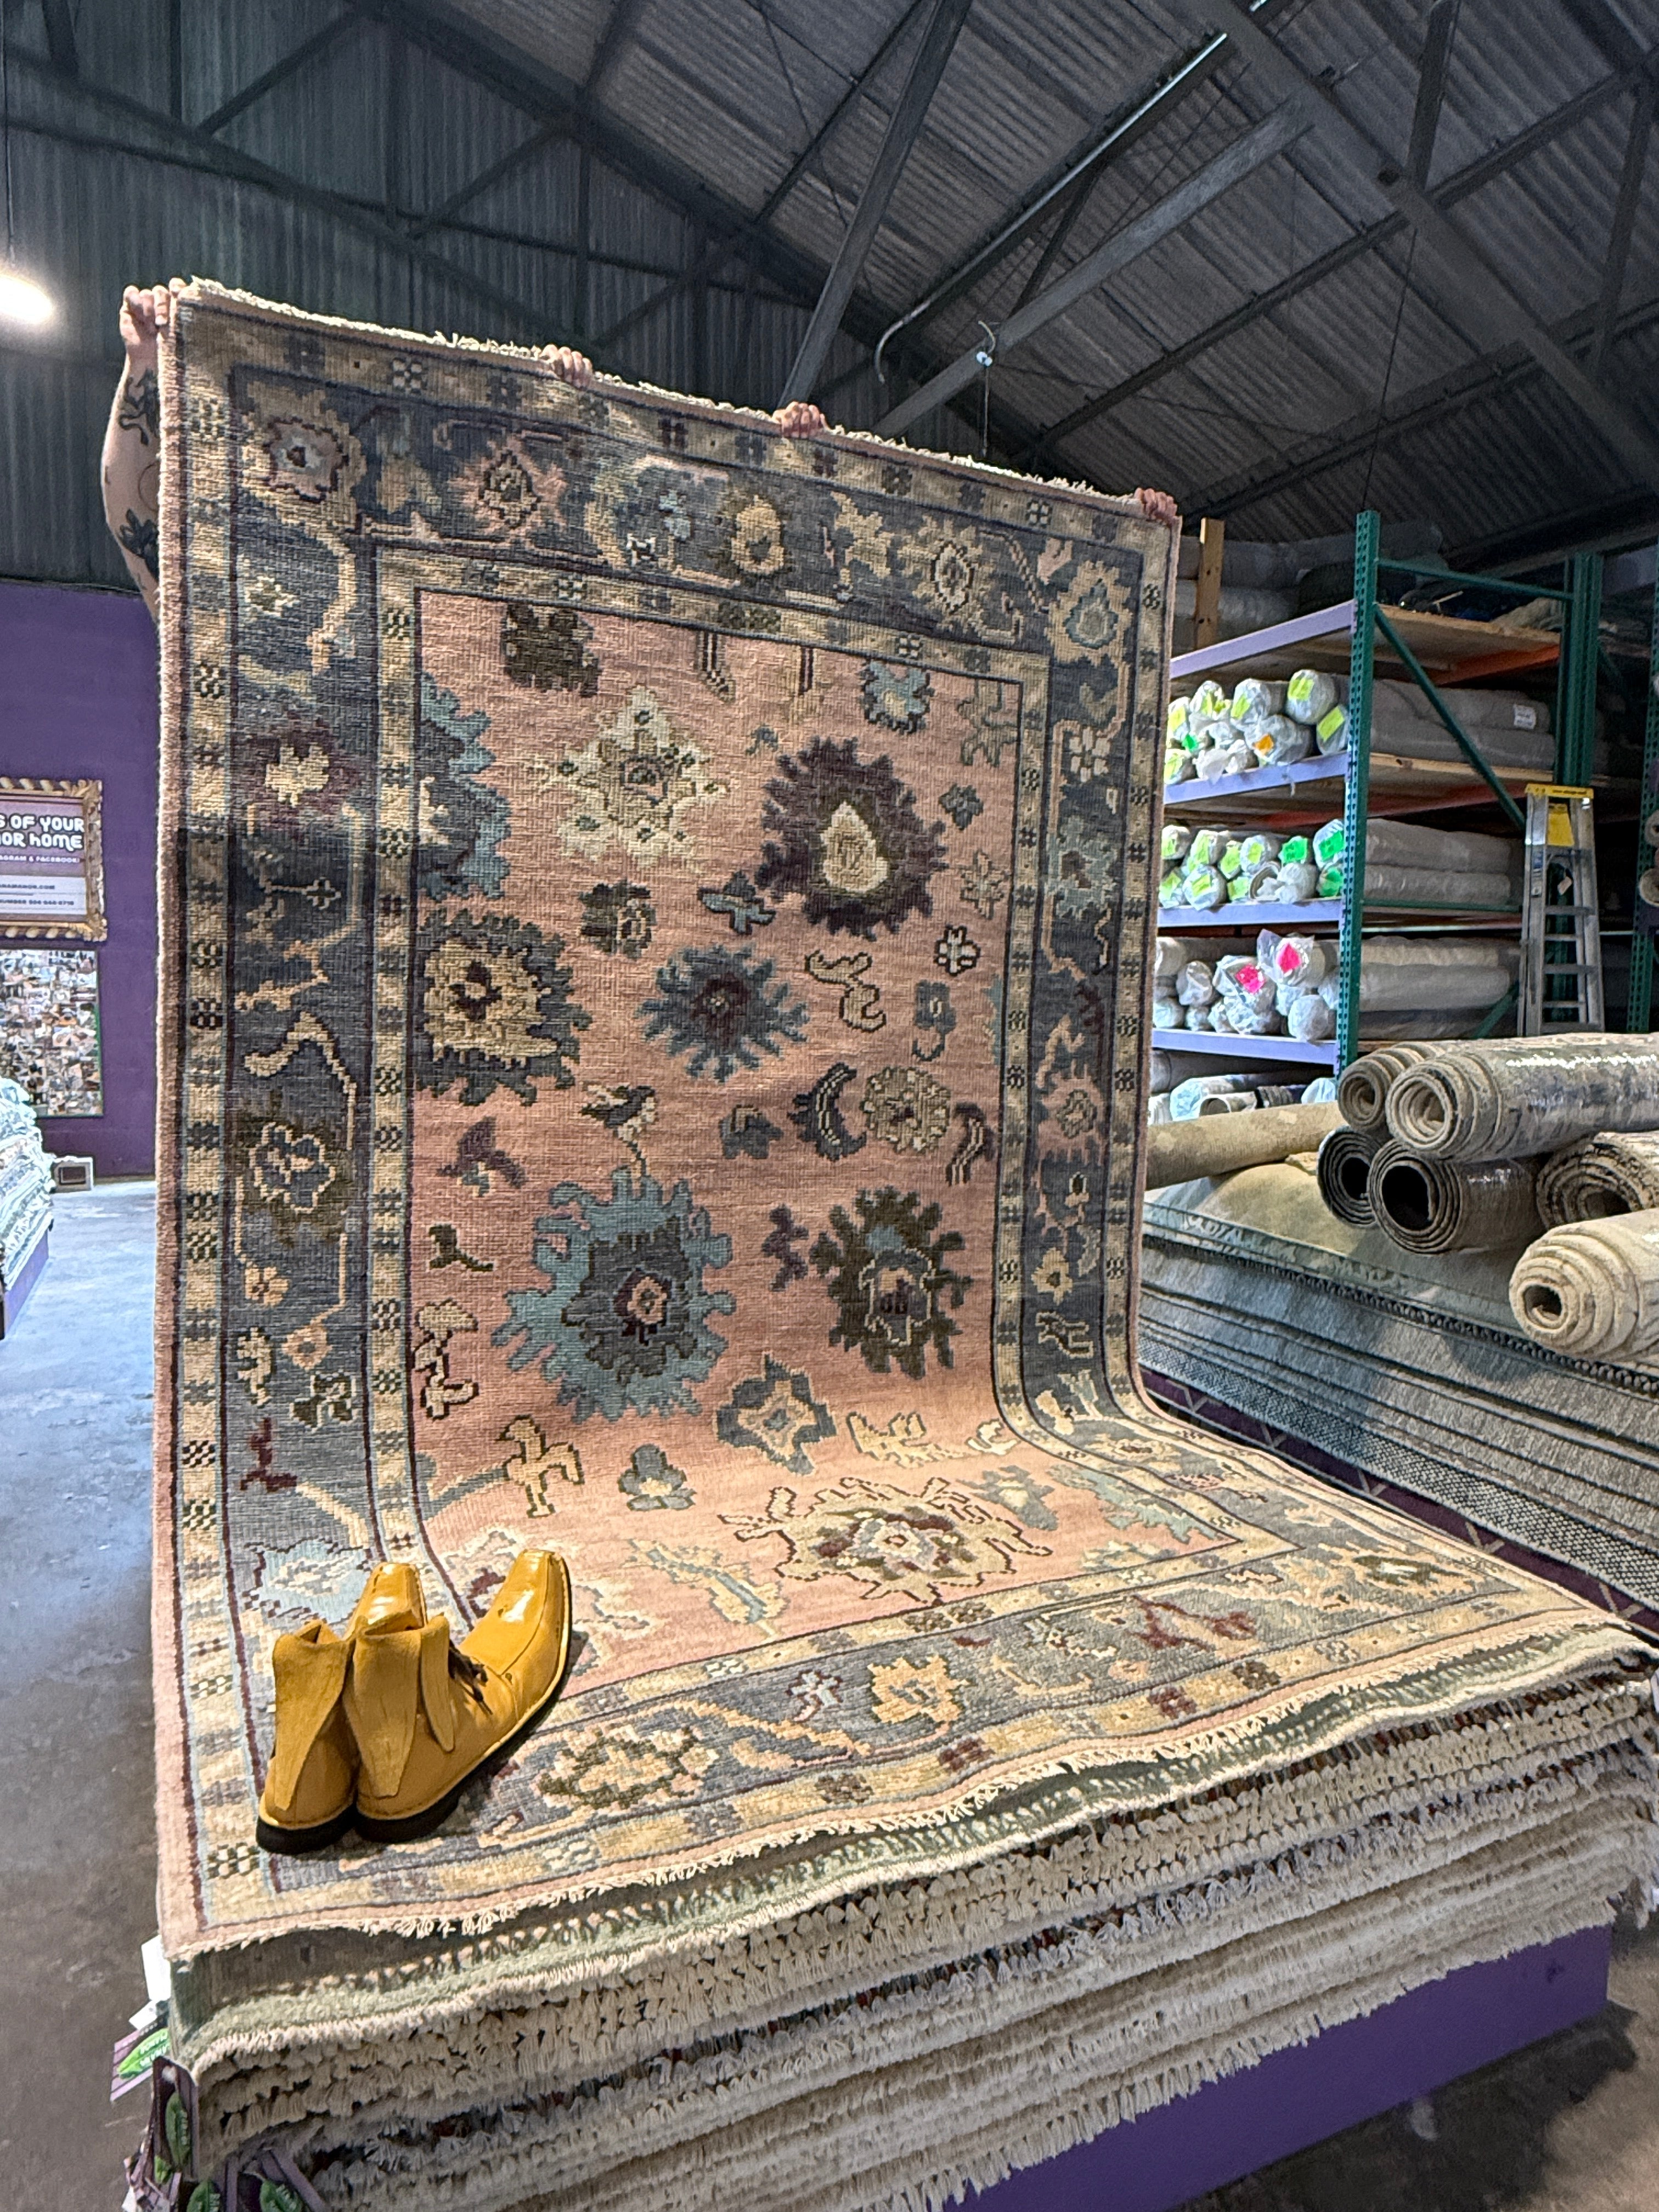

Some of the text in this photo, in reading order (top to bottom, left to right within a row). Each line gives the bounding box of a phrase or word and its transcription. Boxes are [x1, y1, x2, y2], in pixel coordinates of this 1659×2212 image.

[10, 815, 35, 830] OF
[40, 816, 84, 833] YOUR
[0, 833, 26, 847] OR
